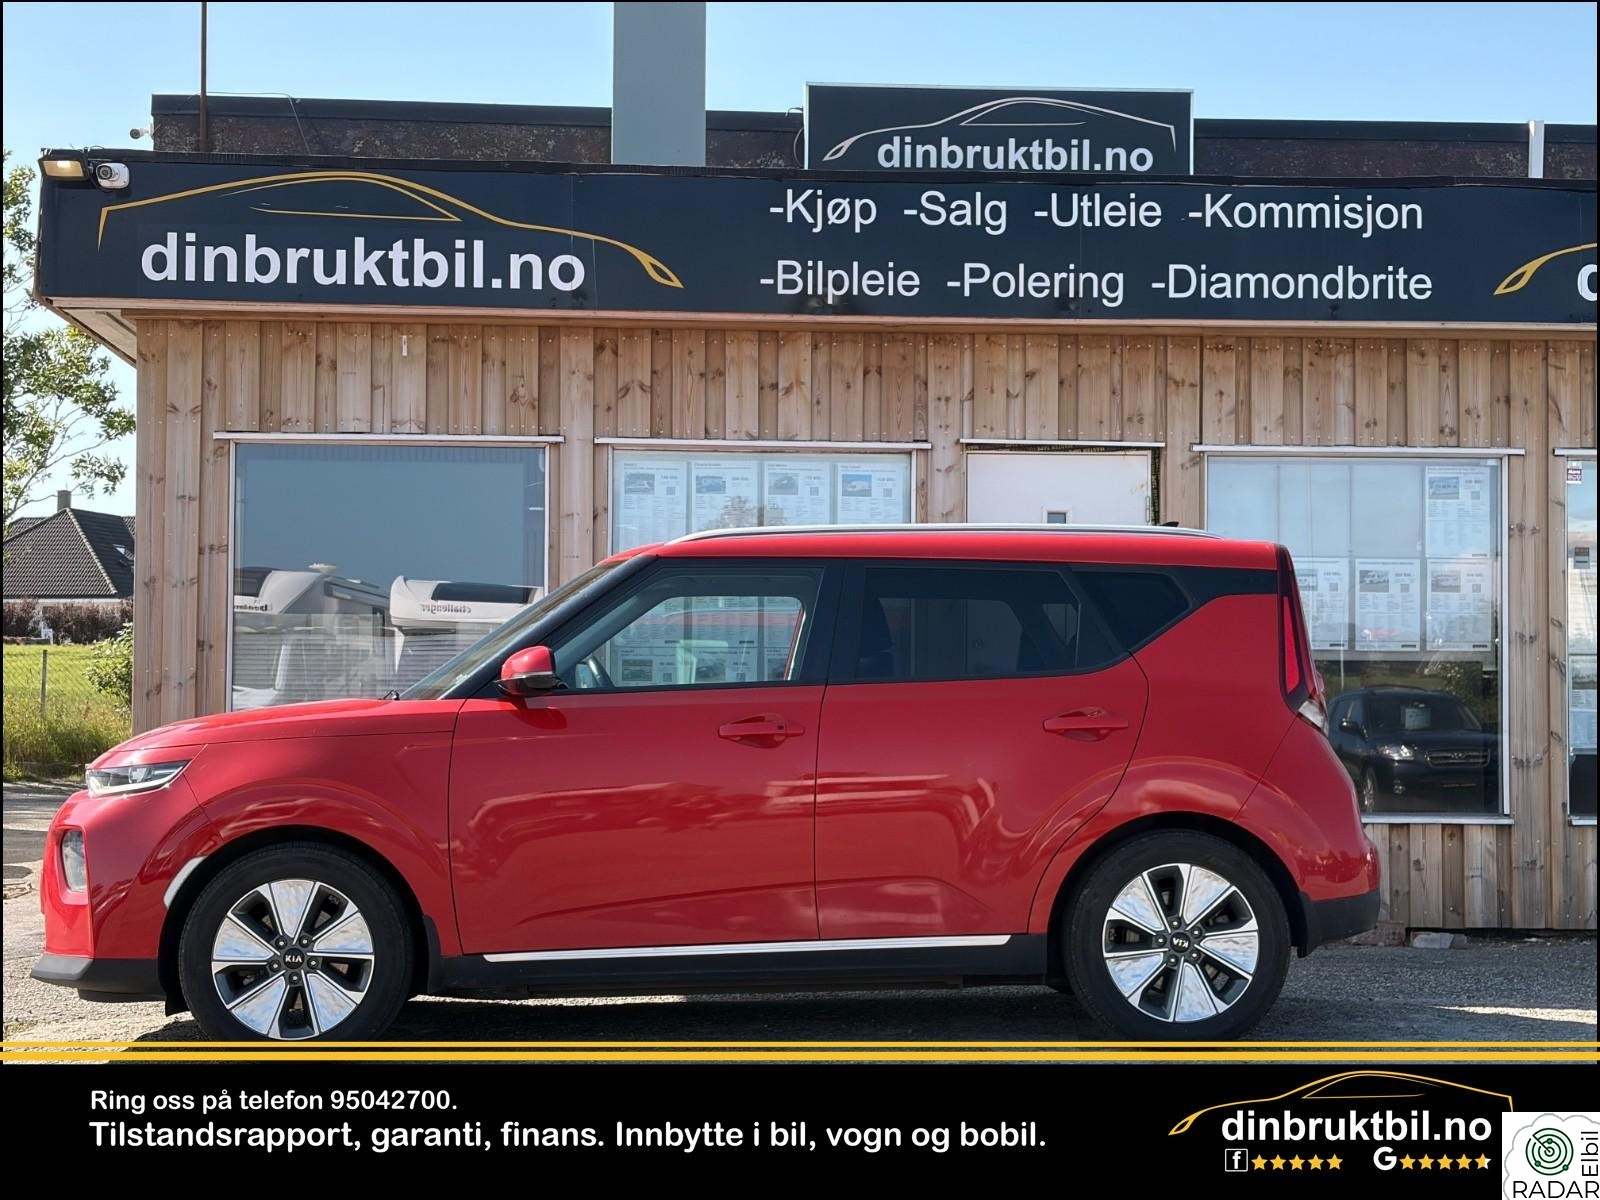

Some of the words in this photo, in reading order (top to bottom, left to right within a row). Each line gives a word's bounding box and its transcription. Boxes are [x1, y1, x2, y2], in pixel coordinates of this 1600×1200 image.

[877, 136, 1154, 172] dinbruktbil.no
[769, 189, 877, 233] -Kjøp
[903, 191, 1007, 236] -Salg
[1034, 193, 1162, 228] -Utleie
[1188, 194, 1423, 239] -Kommisjon
[141, 232, 586, 291] dinbruktbil.no
[759, 260, 920, 304] -Bilpleie
[946, 263, 1124, 308] -Polering
[1151, 264, 1433, 300] -Diamondbrite
[285, 955, 302, 963] KIA
[1173, 937, 1189, 949] KIA
